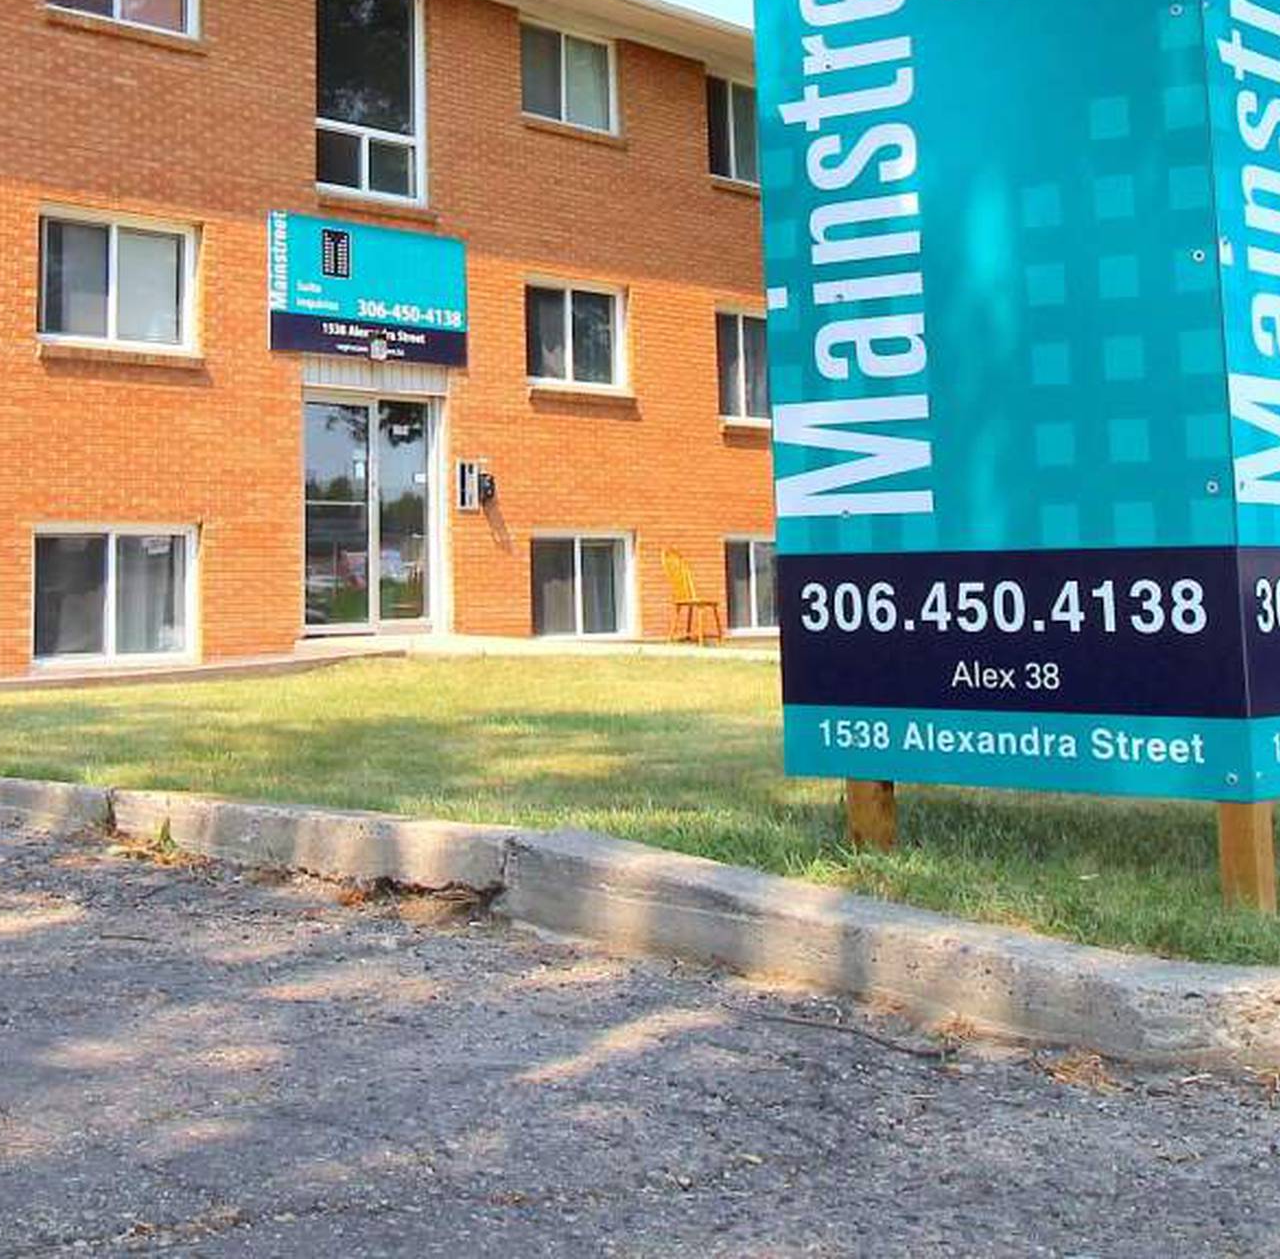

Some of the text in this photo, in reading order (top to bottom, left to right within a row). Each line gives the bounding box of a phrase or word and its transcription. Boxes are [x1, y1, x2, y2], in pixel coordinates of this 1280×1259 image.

[356, 298, 462, 328] 306-450-4138
[322, 322, 347, 337] 1538
[801, 578, 1208, 633] 306.450.4138
[951, 660, 1061, 690] Alex 38
[819, 719, 1206, 765] 1538 Alexandra Street
